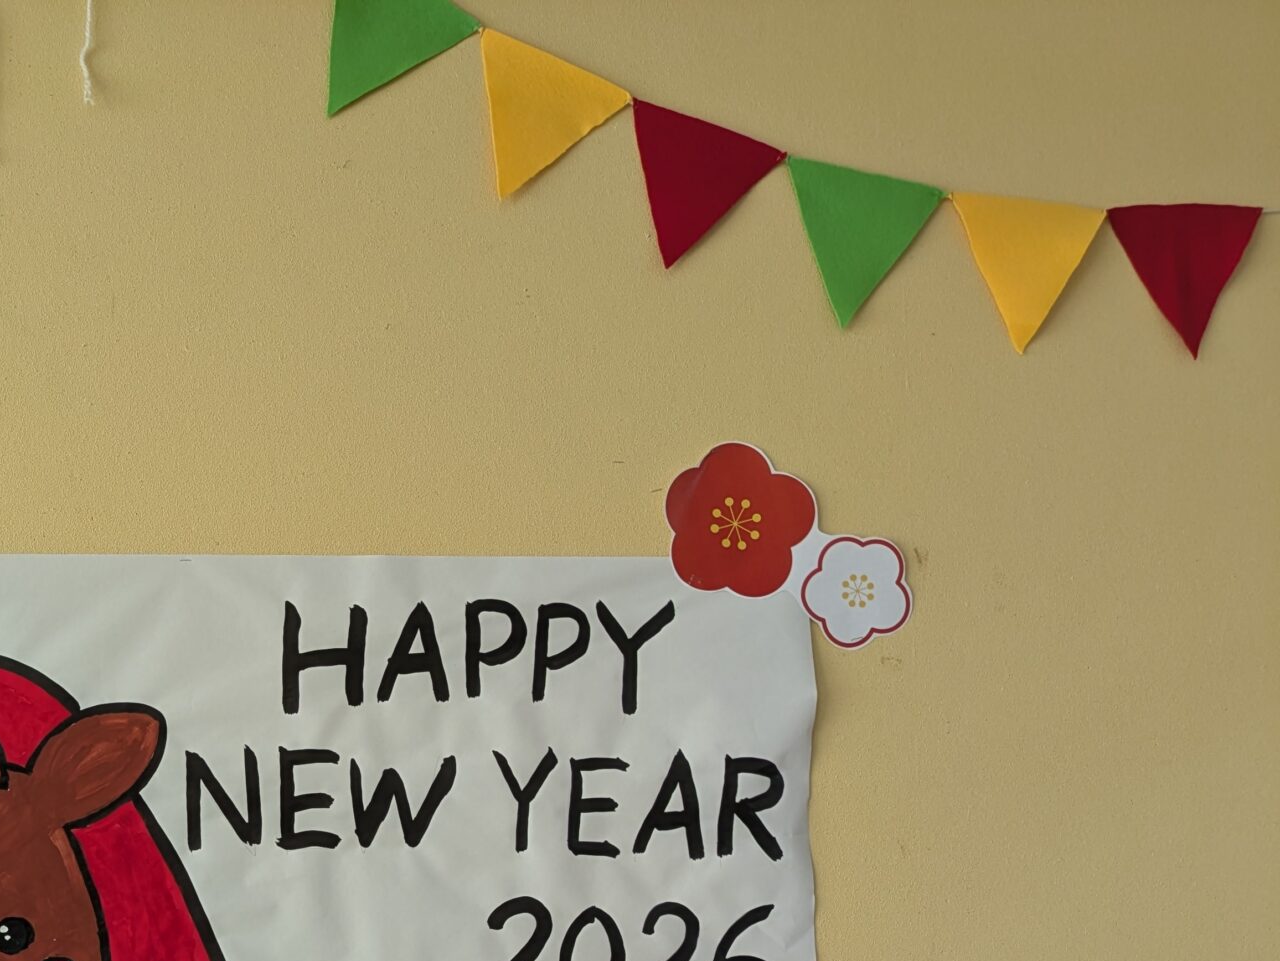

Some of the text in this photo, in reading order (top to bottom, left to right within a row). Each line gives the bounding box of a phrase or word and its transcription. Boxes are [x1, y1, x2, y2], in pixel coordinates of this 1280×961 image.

[281, 599, 676, 715] HAPPY
[184, 744, 785, 862] NEW YEAR
